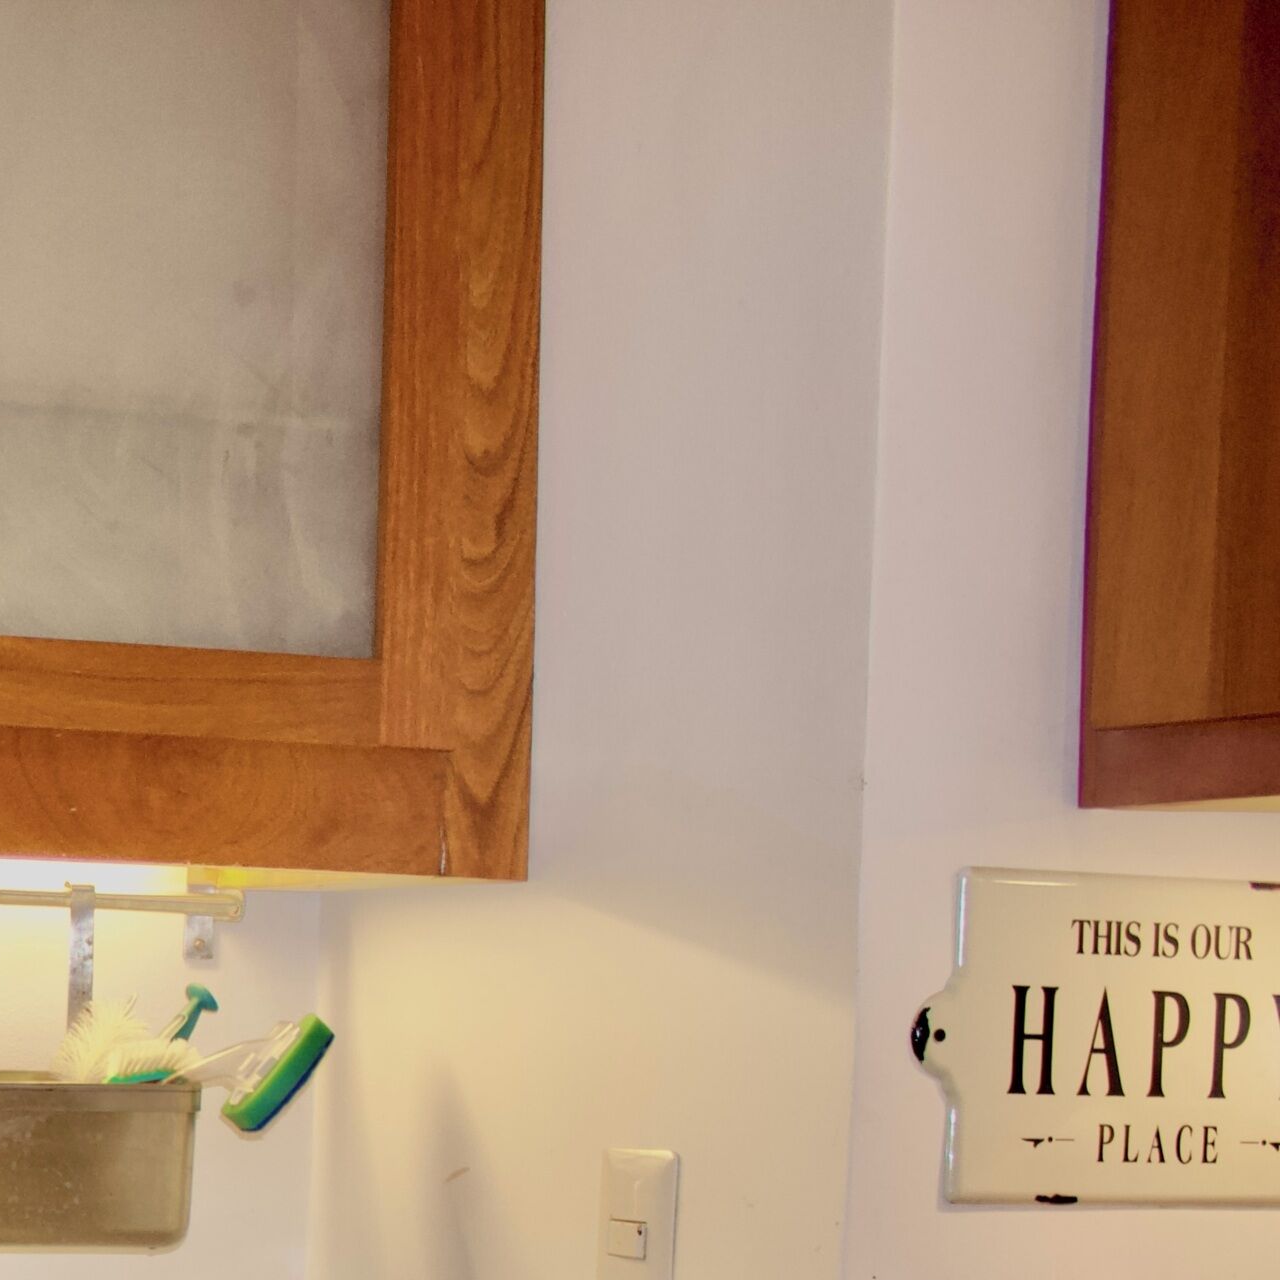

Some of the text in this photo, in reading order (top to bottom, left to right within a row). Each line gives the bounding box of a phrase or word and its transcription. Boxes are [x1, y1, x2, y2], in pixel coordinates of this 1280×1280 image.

[1071, 919, 1254, 961] THIS IS OUR
[1096, 1123, 1219, 1165] PLACE
